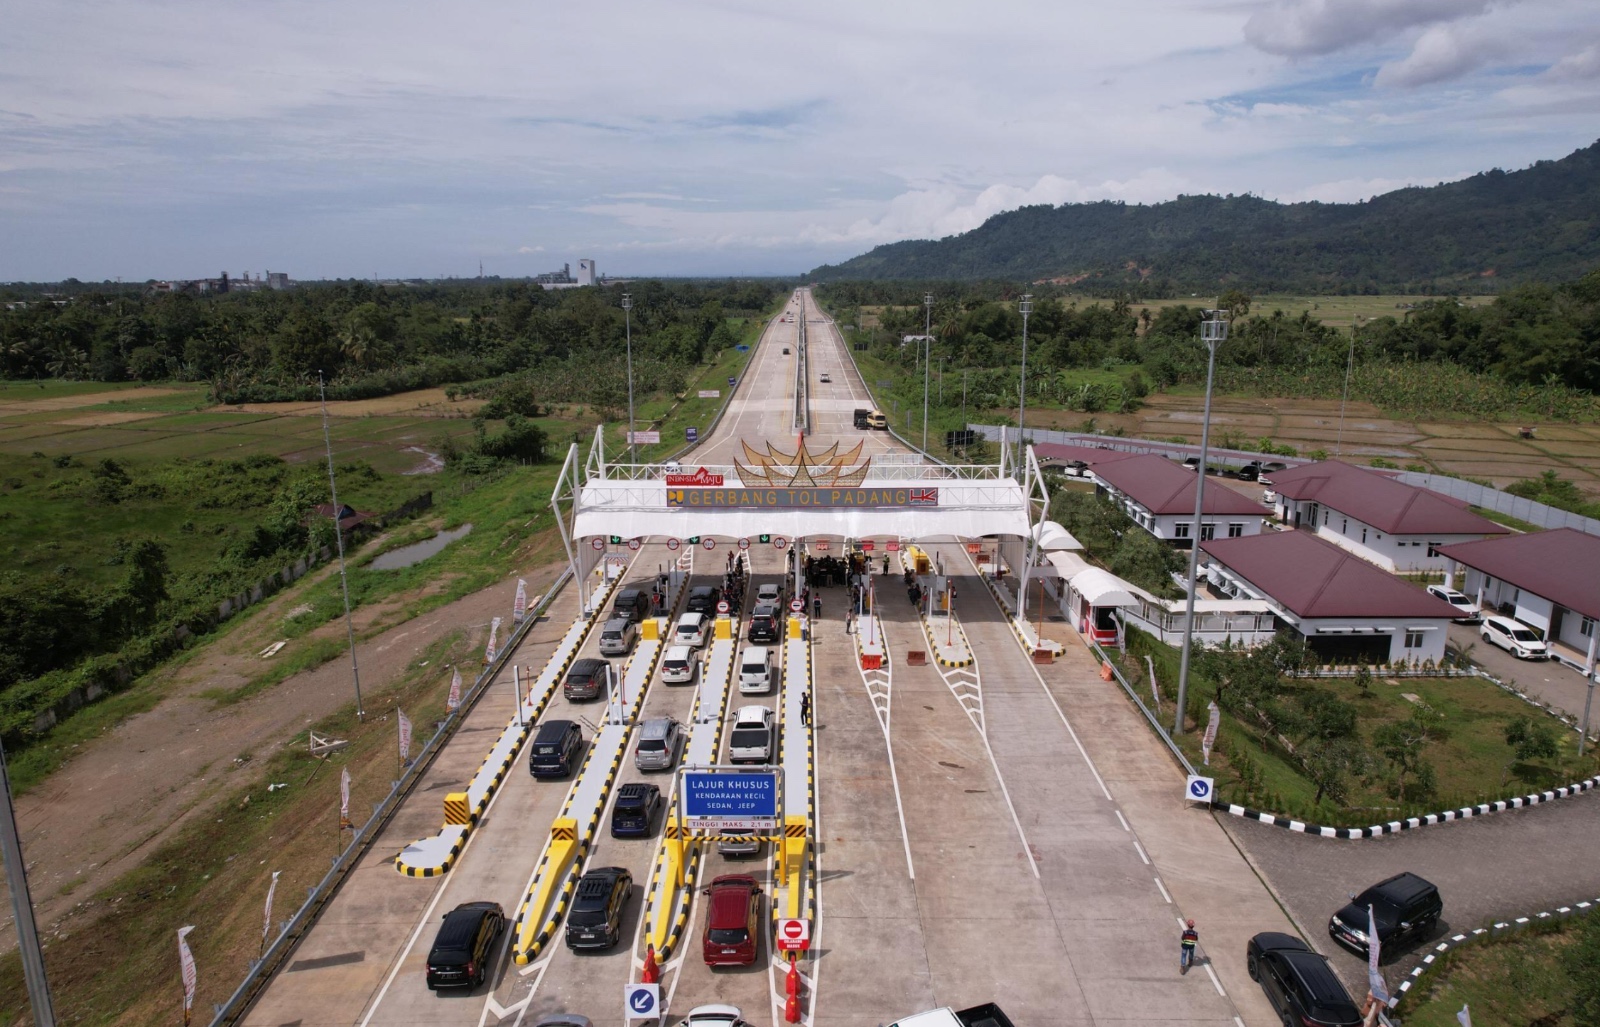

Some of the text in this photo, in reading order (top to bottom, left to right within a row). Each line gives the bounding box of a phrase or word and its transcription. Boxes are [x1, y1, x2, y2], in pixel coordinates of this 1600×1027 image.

[700, 475, 723, 485] MAJU
[689, 490, 906, 505] GERBANG TOL PADANG
[692, 781, 769, 789] LAJUR KHUSUS
